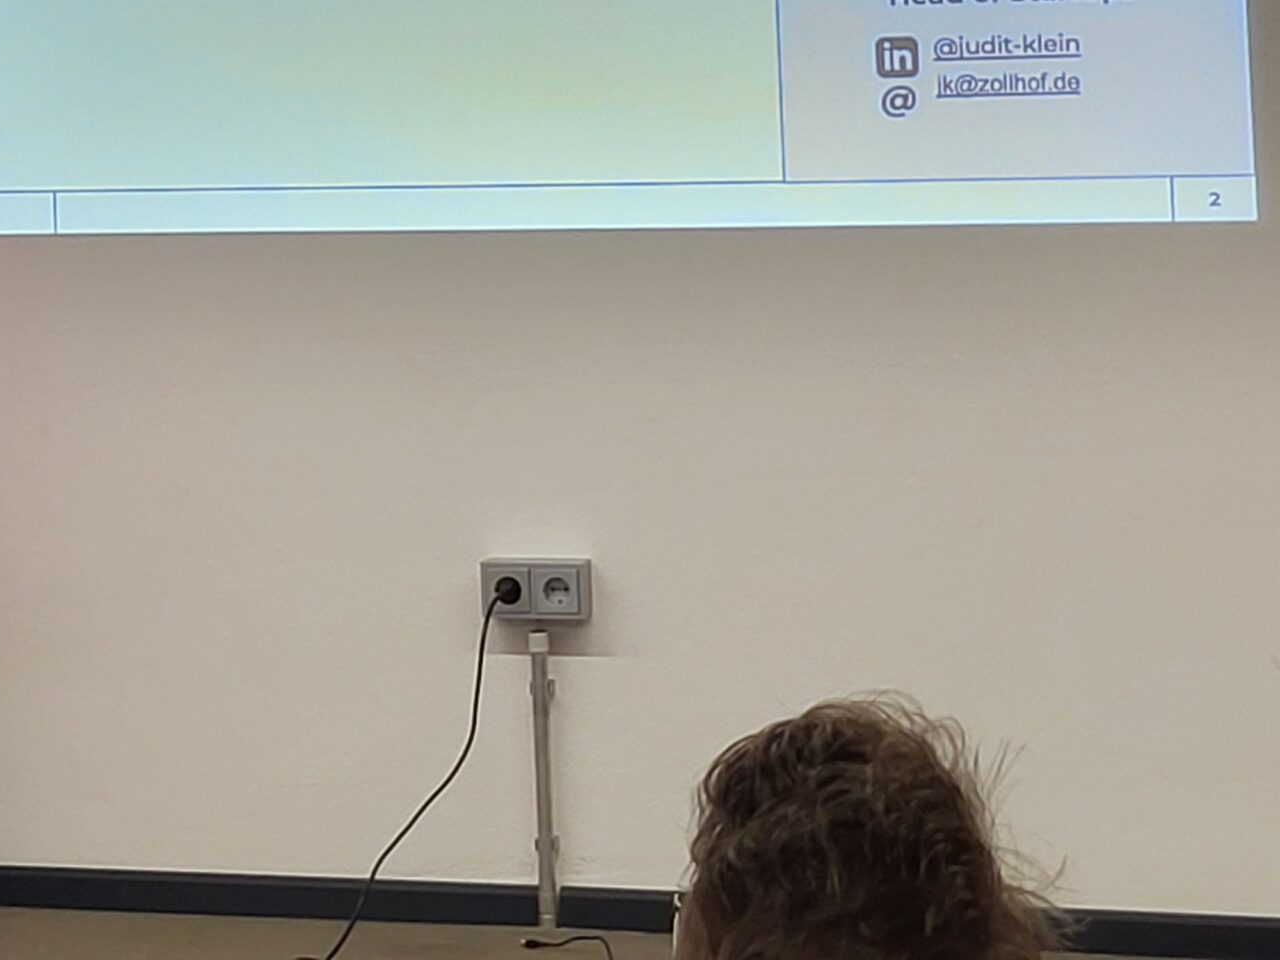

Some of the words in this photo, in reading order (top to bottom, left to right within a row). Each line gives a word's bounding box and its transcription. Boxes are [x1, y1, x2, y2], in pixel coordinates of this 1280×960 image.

[881, 41, 913, 73] in
[933, 33, 1081, 60] @judit-klein
[881, 85, 916, 118] @
[1208, 191, 1221, 207] 2
